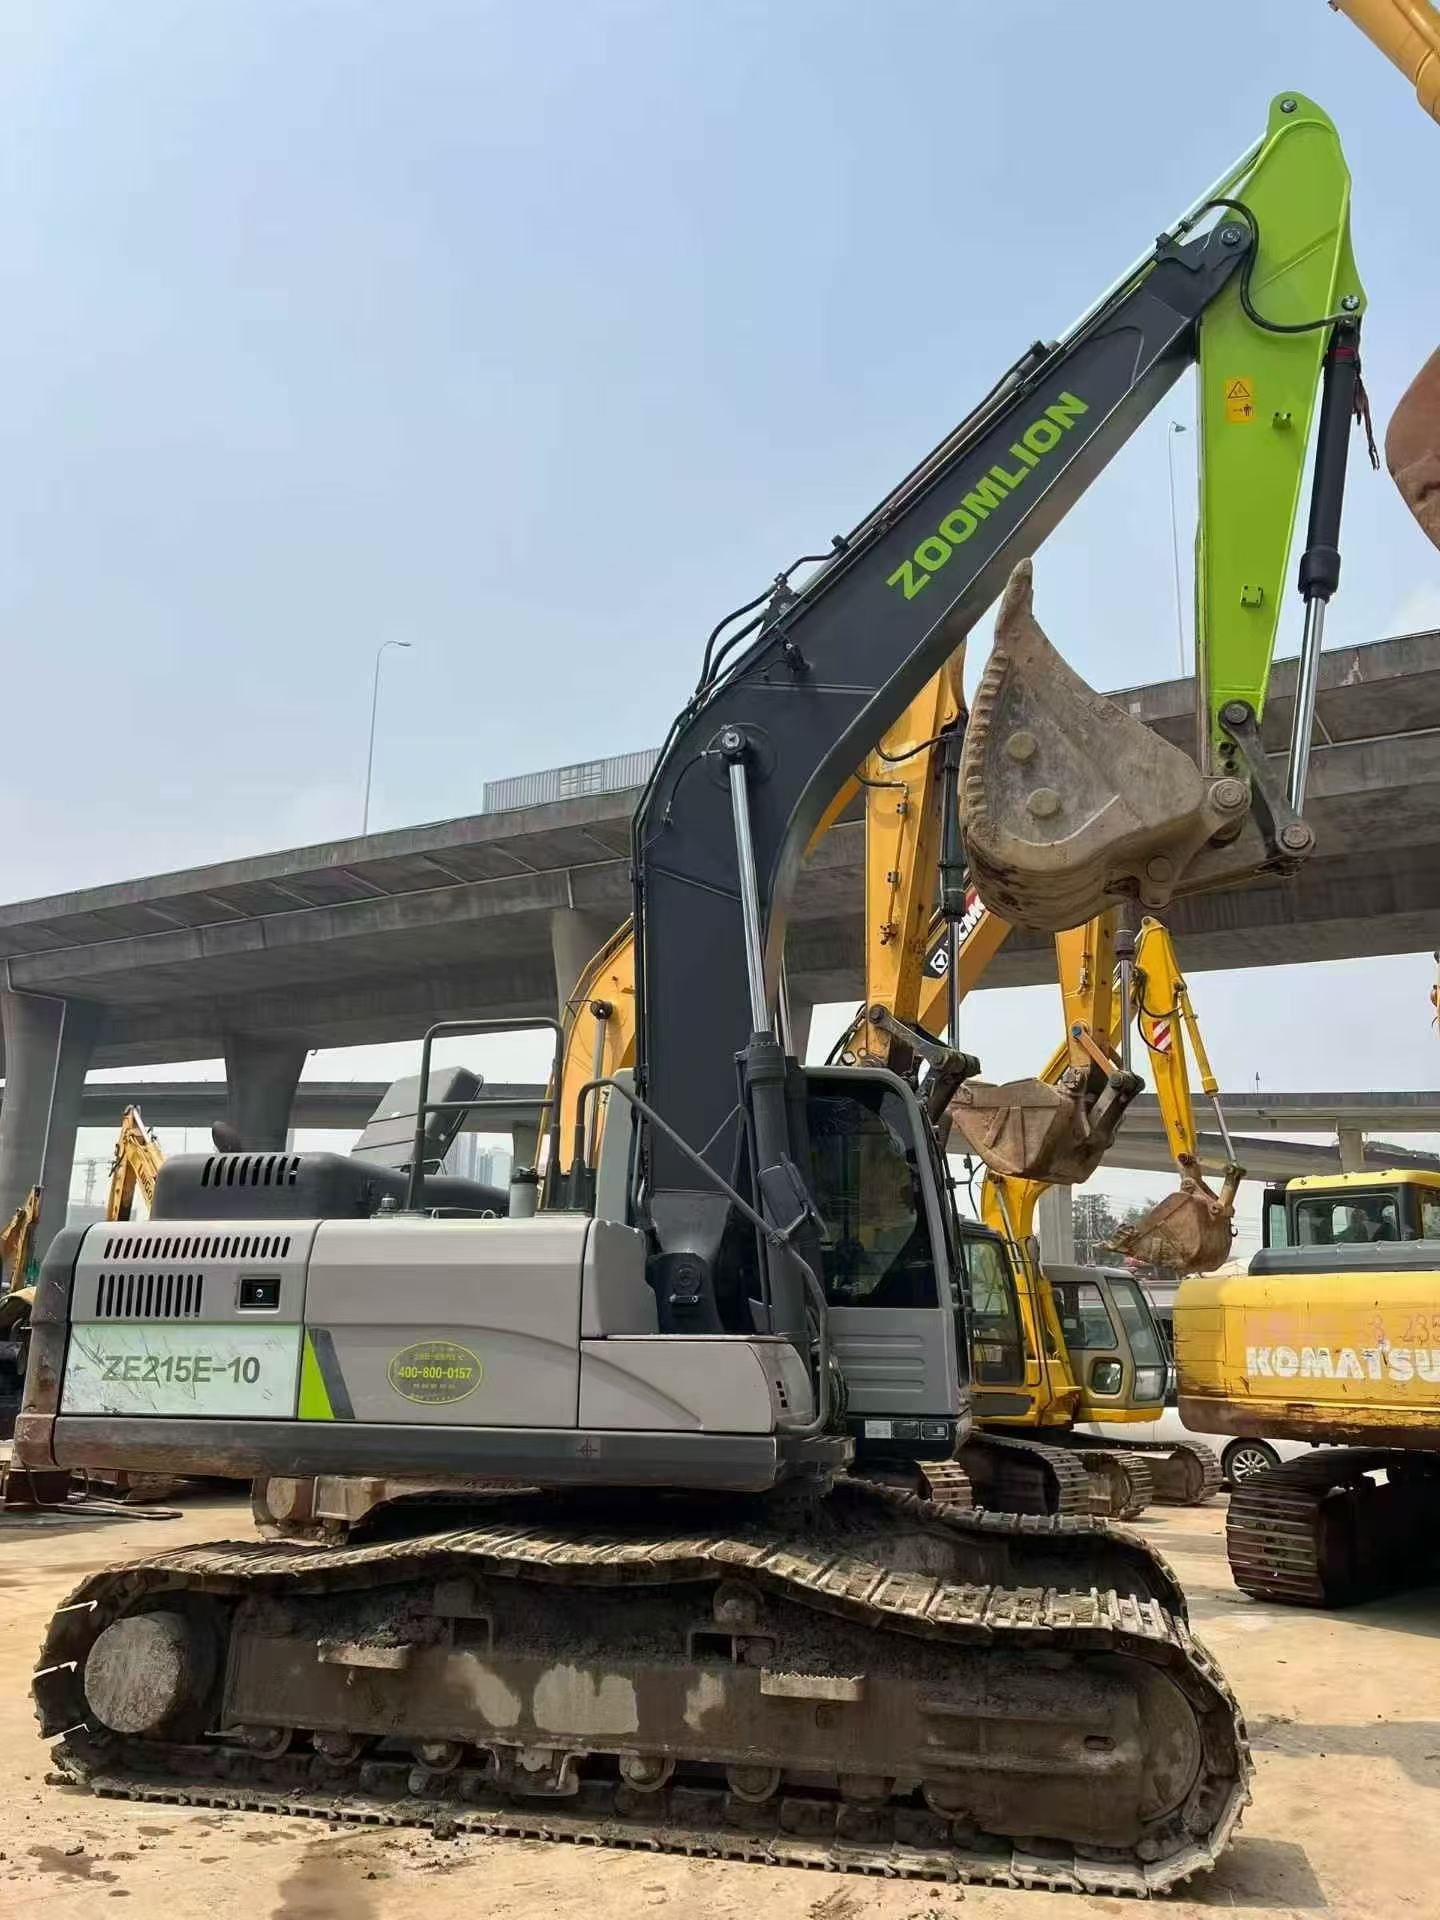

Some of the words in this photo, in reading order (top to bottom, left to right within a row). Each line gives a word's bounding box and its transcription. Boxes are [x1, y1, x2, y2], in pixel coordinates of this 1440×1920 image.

[886, 391, 1089, 600] ZOOMLION
[102, 1355, 260, 1383] ZE215E-10
[399, 1366, 472, 1379] 400-800-0157
[1247, 1346, 1440, 1383] KOMATSU
